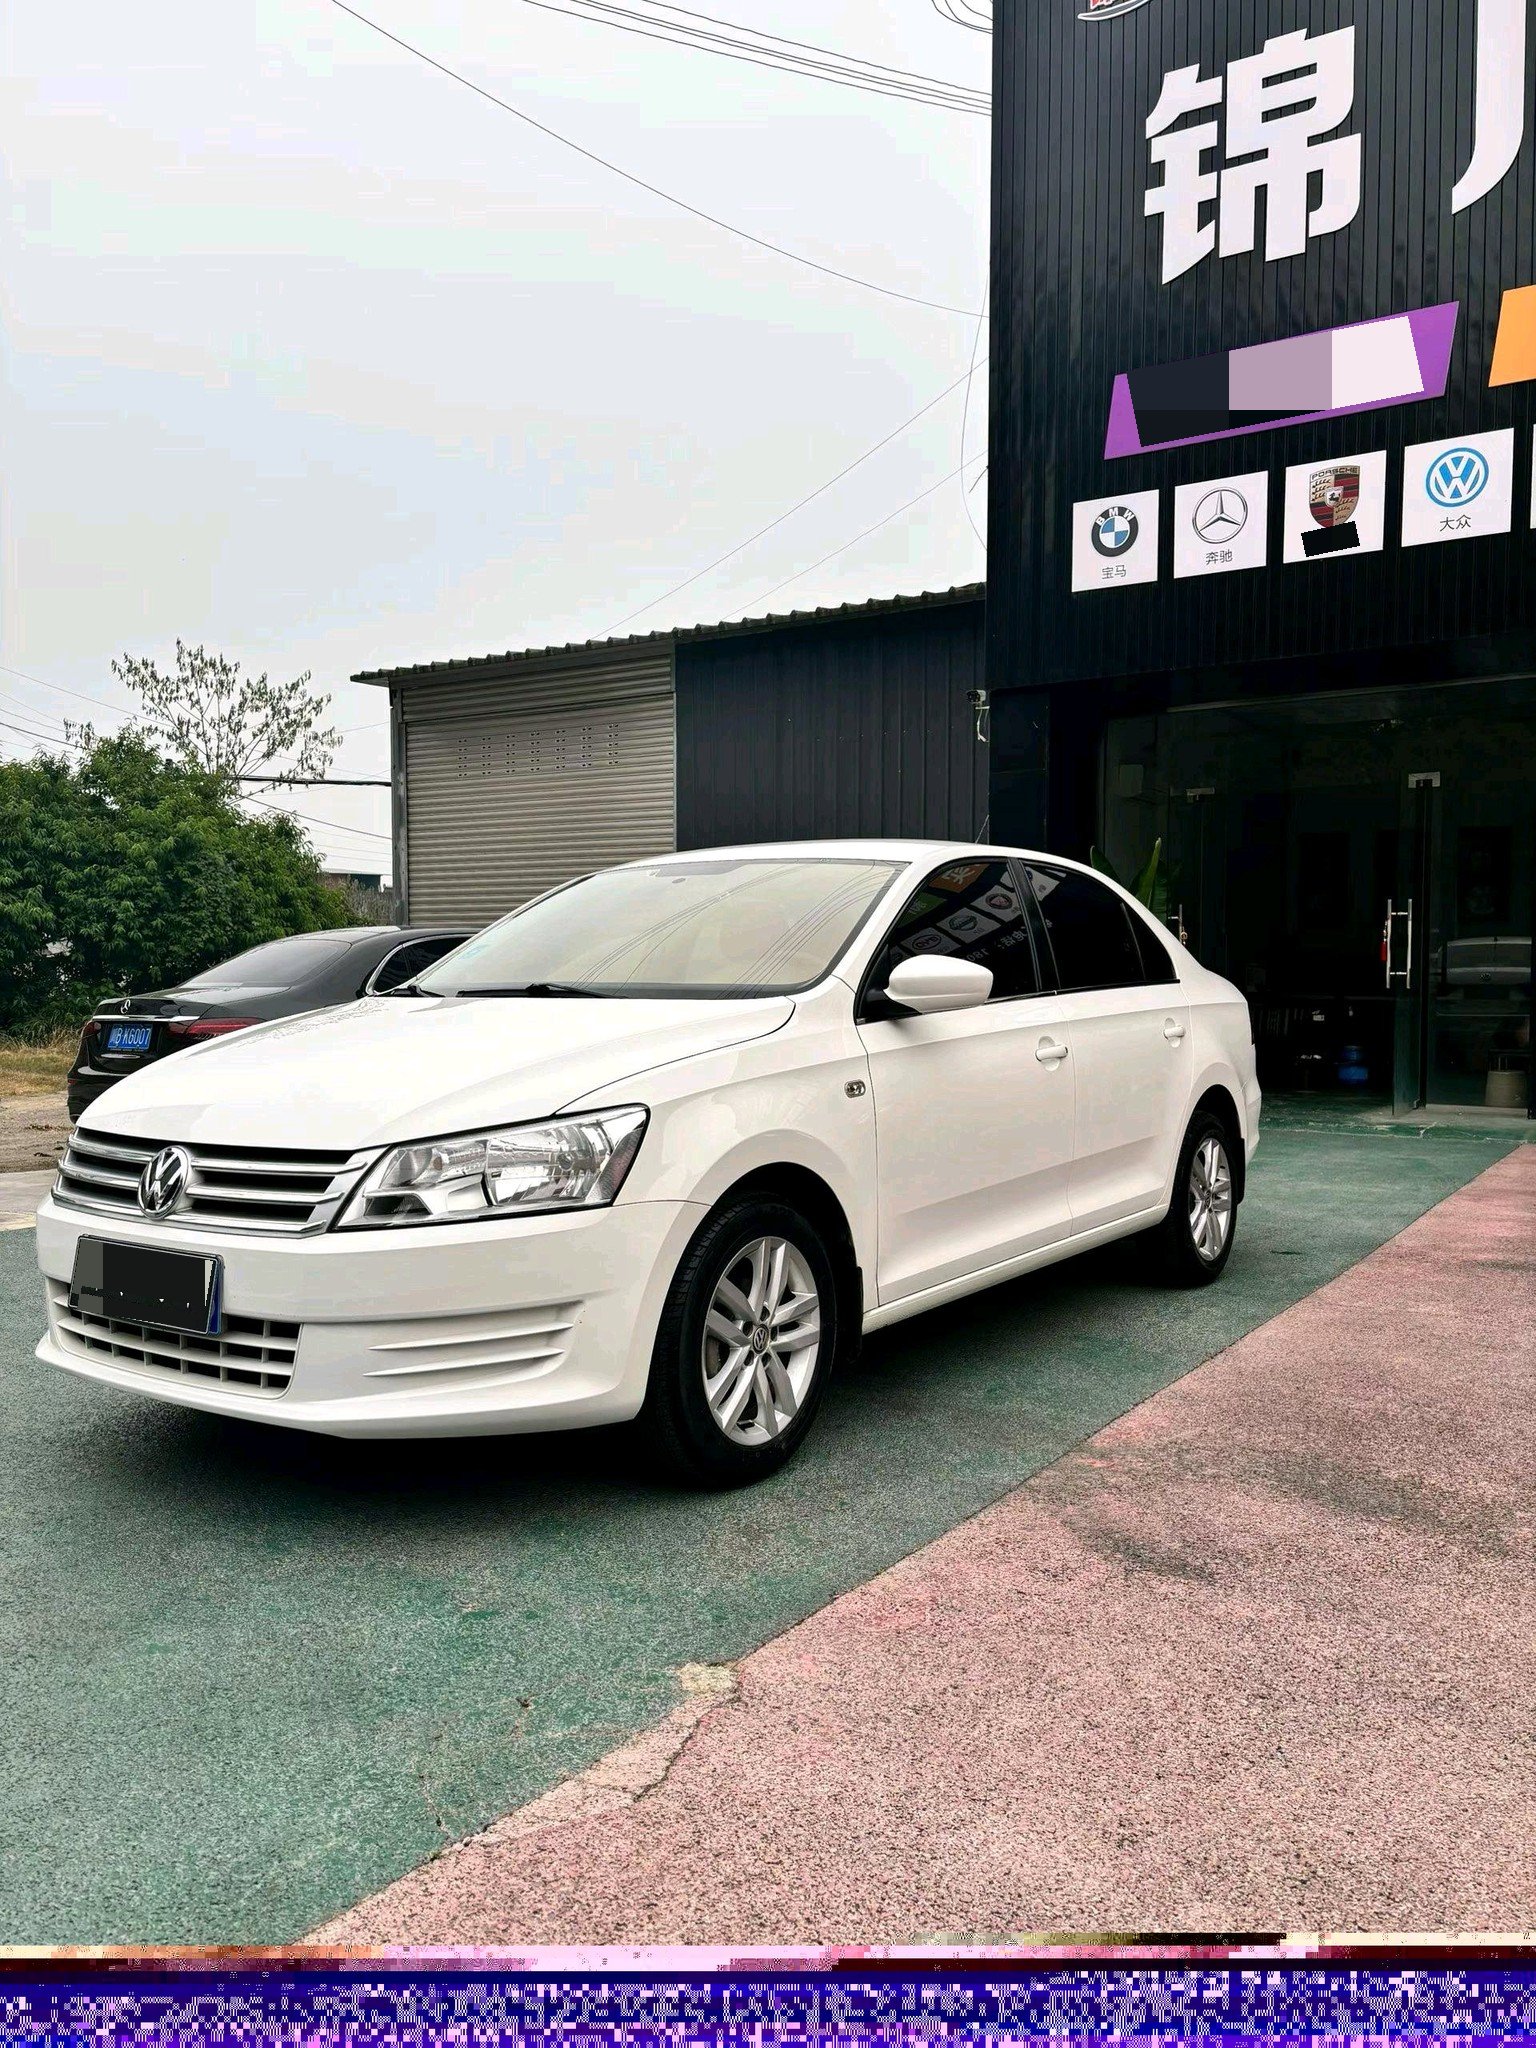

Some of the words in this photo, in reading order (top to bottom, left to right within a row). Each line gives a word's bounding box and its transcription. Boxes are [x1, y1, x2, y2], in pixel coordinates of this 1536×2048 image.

[1311, 466, 1359, 481] PORSCHE
[1096, 506, 1136, 526] BMW
[1439, 514, 1472, 532] 大众
[1205, 549, 1233, 565] 奔驰
[1101, 564, 1127, 580] 宝马
